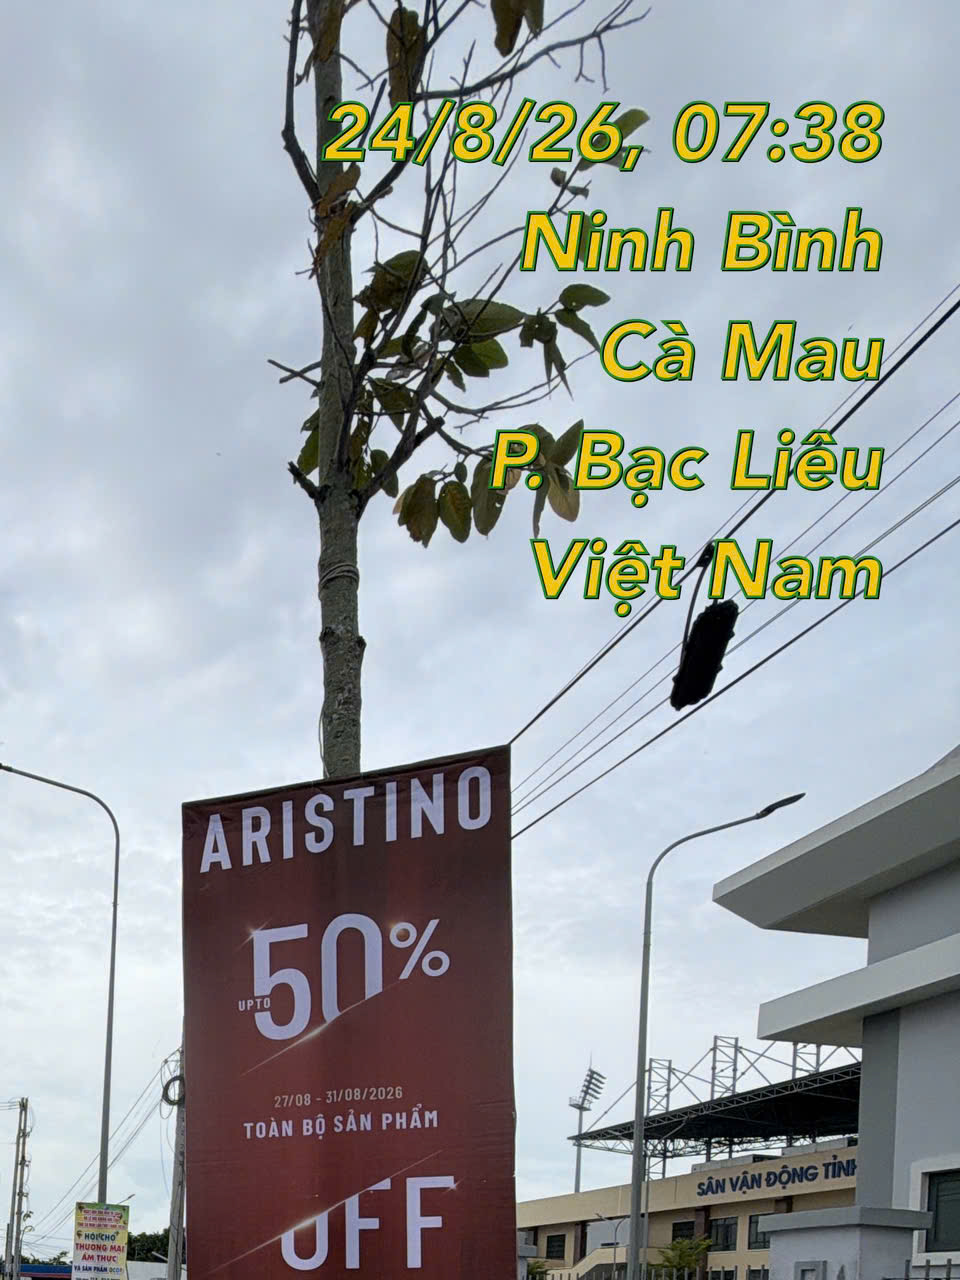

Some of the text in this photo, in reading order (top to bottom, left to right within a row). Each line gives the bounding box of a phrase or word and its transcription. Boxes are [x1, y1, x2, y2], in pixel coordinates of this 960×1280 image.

[200, 765, 492, 874] ARISTINO
[252, 913, 451, 1041] 50%
[244, 1103, 439, 1141] TOÀN BỘ SẢN PHẨM
[274, 1093, 312, 1109] 27/08
[325, 1086, 403, 1104] 31/08/2026
[697, 1176, 726, 1197] SÂN
[729, 1170, 762, 1194] VẬN
[765, 1165, 819, 1190] ĐỘNG
[280, 1176, 456, 1271] OFF
